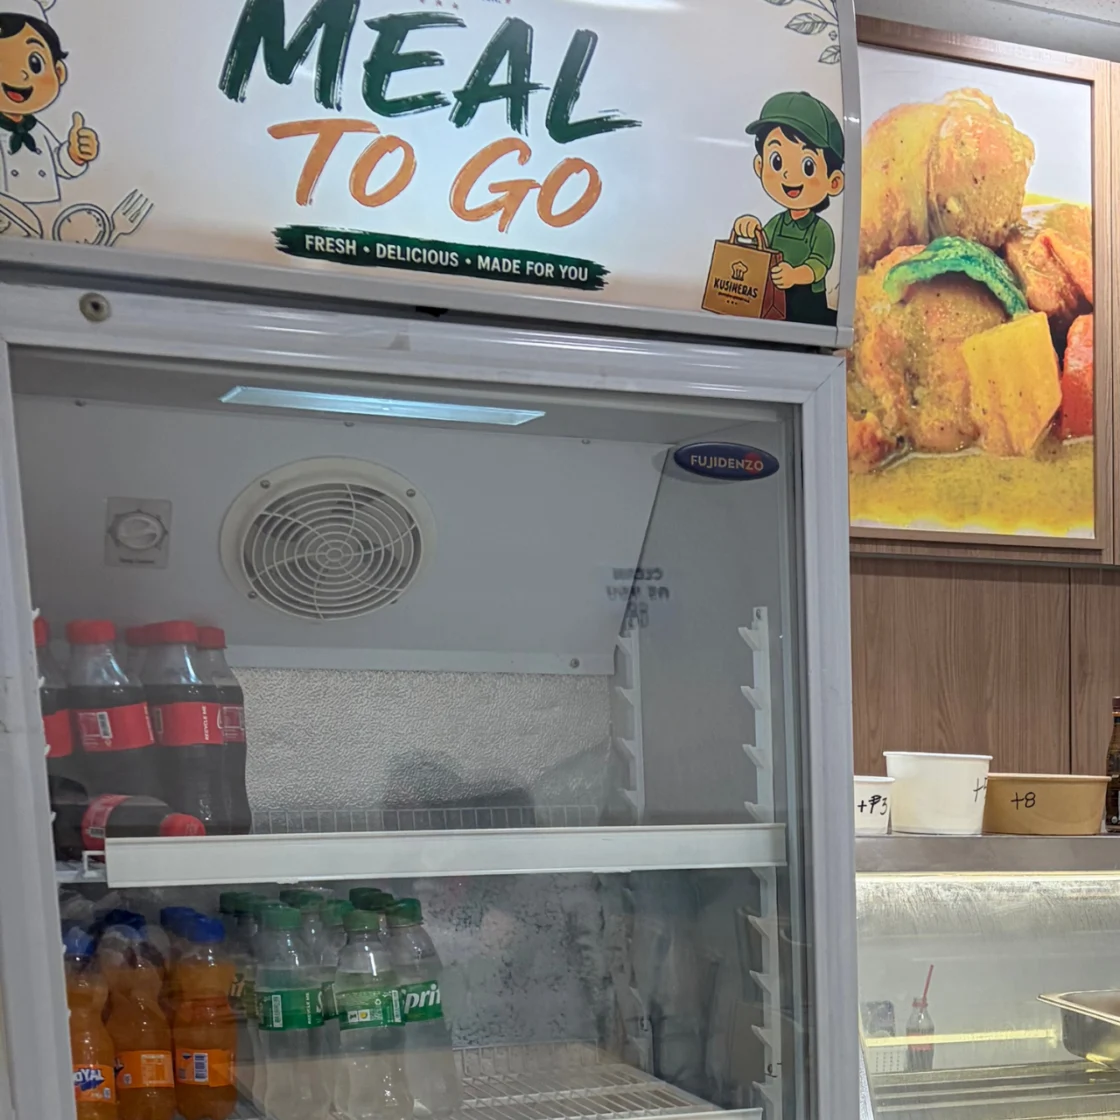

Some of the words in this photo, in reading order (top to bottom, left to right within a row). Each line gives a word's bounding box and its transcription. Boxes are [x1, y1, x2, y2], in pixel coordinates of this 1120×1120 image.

[218, 0, 643, 144] MEAL
[267, 118, 417, 208] TO
[450, 137, 603, 233] GO
[305, 234, 357, 256] FRESH
[375, 243, 459, 268] DELICIOUS
[477, 254, 521, 275] MADE
[525, 260, 555, 279] FOR
[558, 265, 589, 282] YOU
[690, 454, 764, 472] FUJIDENZO
[1011, 792, 1036, 810] +8
